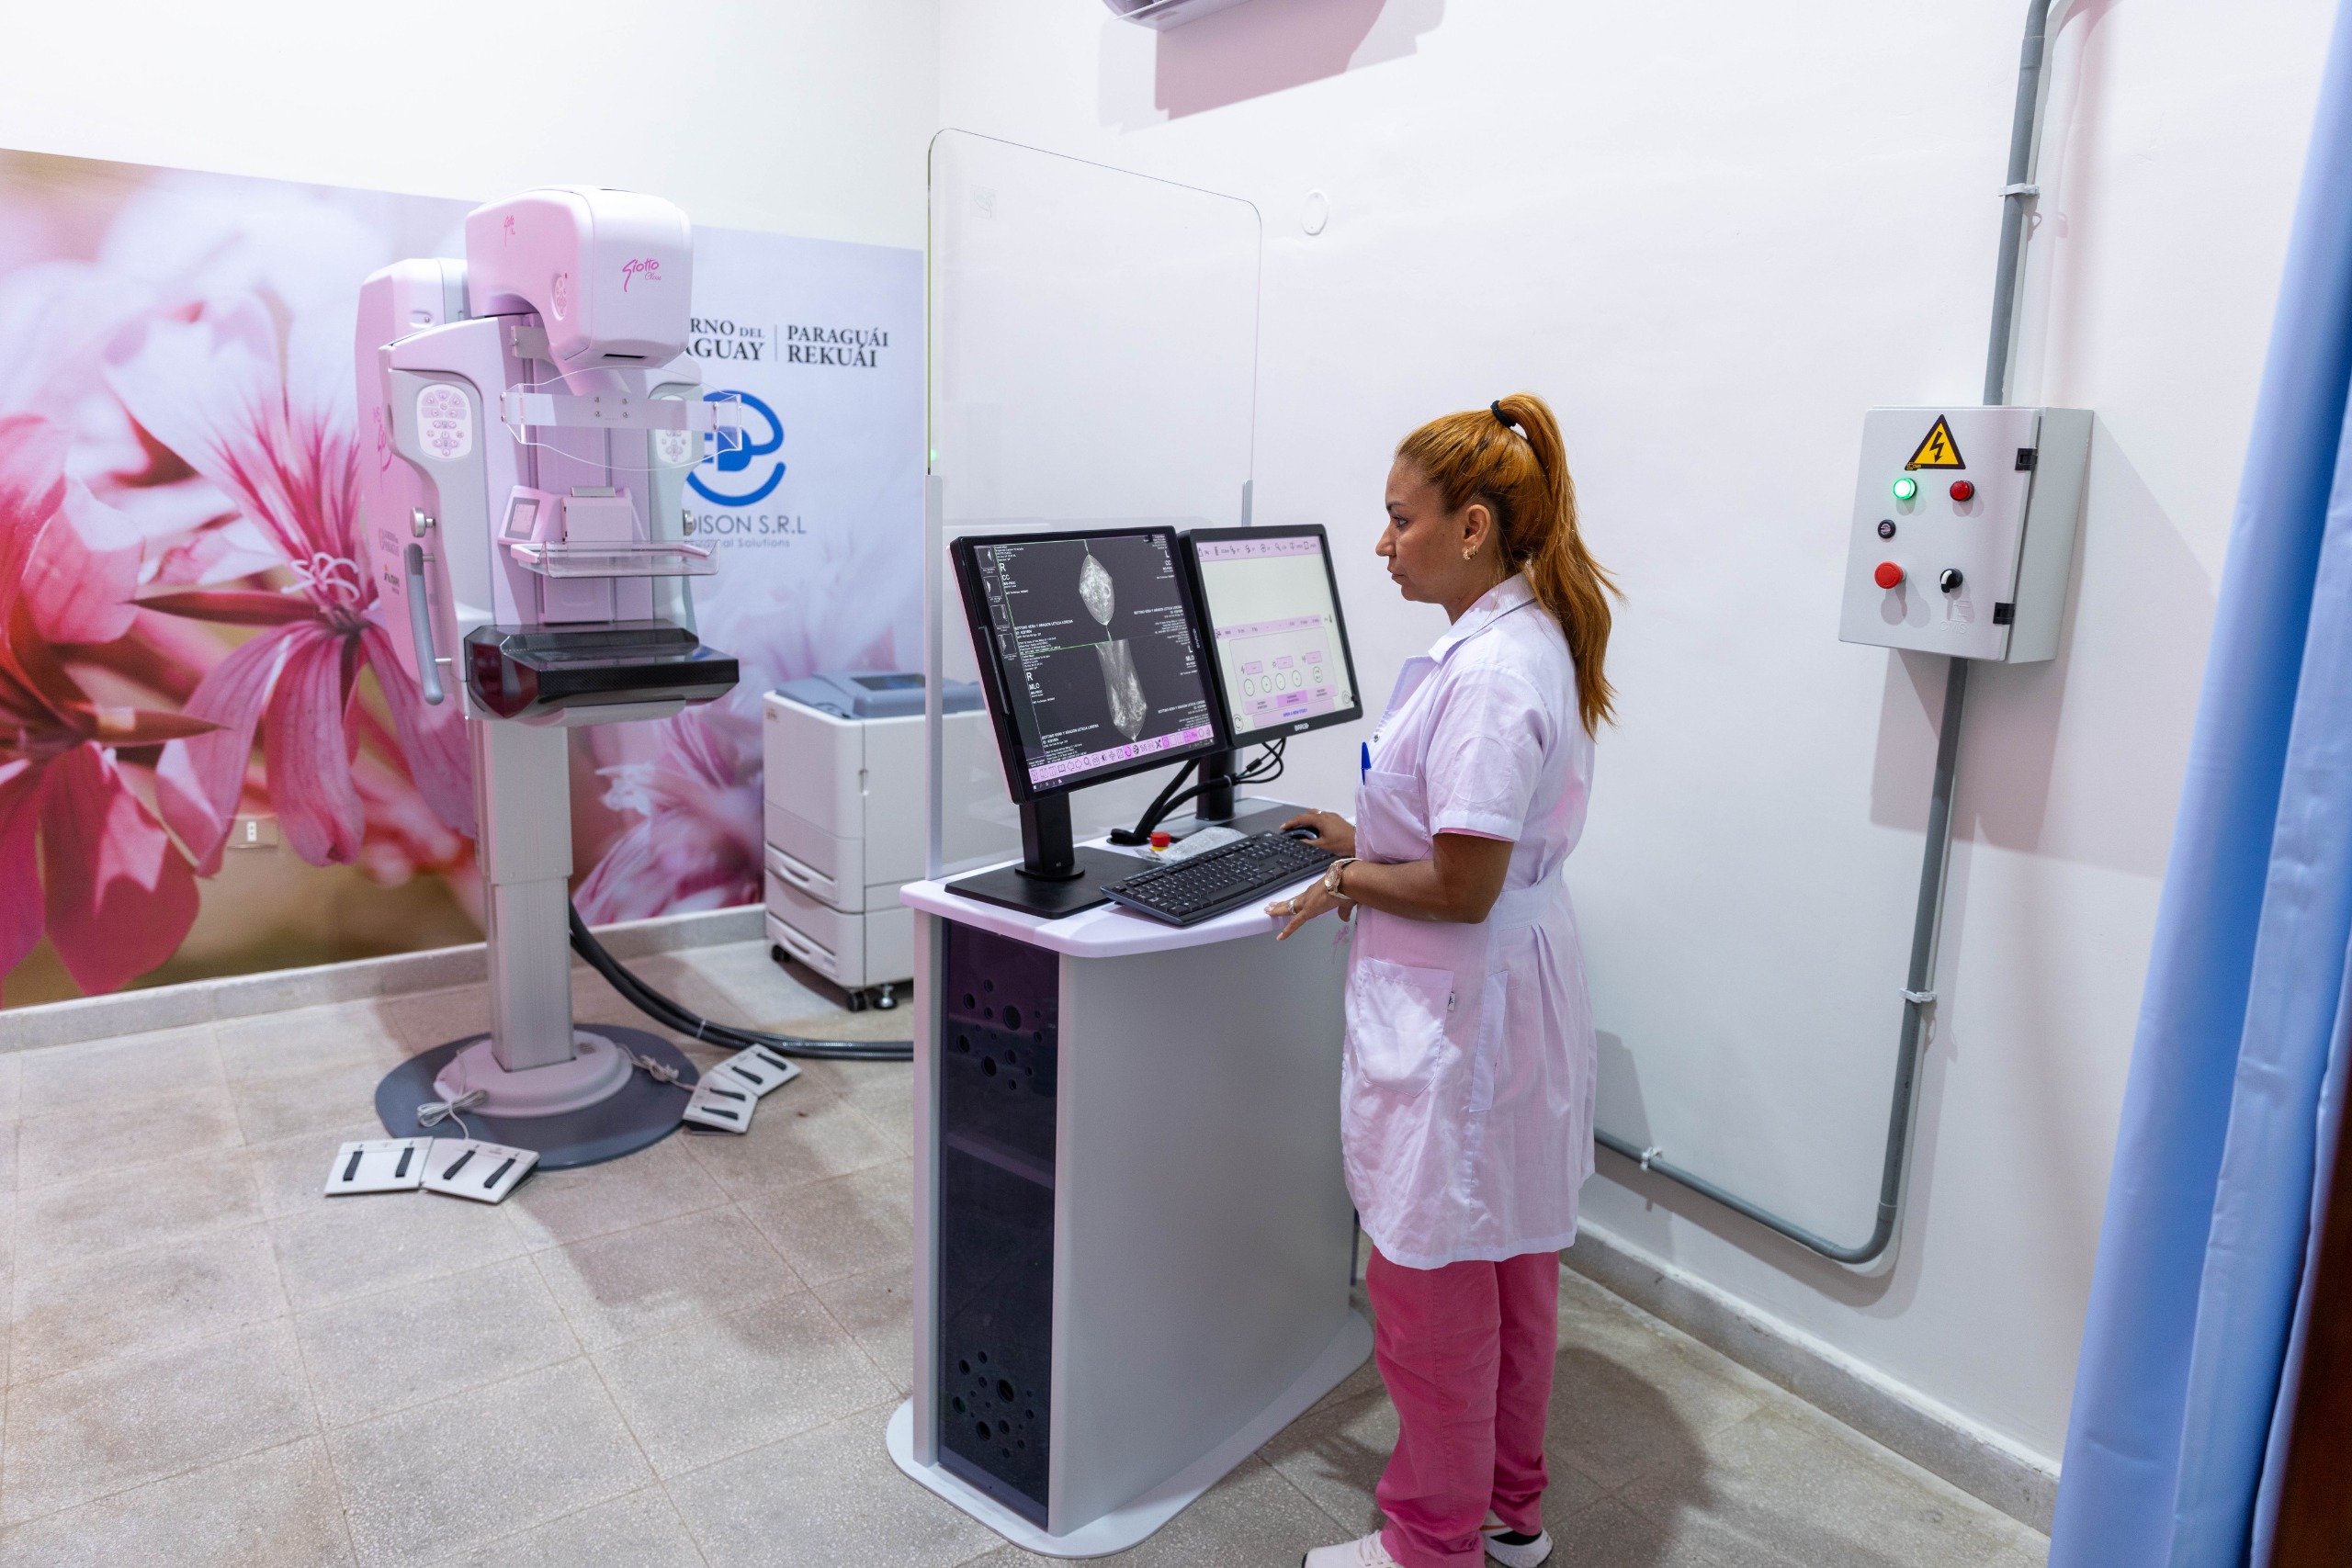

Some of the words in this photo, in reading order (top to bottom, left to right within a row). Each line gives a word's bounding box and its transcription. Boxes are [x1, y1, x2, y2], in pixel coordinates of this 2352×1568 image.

[690, 318, 735, 336] RNO
[740, 327, 764, 339] DEL
[787, 324, 889, 347] PARAGUÁI
[787, 344, 877, 367] REKUÁI
[759, 514, 807, 535] S.R.L
[739, 537, 790, 548] Solutions
[1000, 562, 1006, 571] R
[1188, 645, 1193, 653] L
[1026, 671, 1034, 681] R
